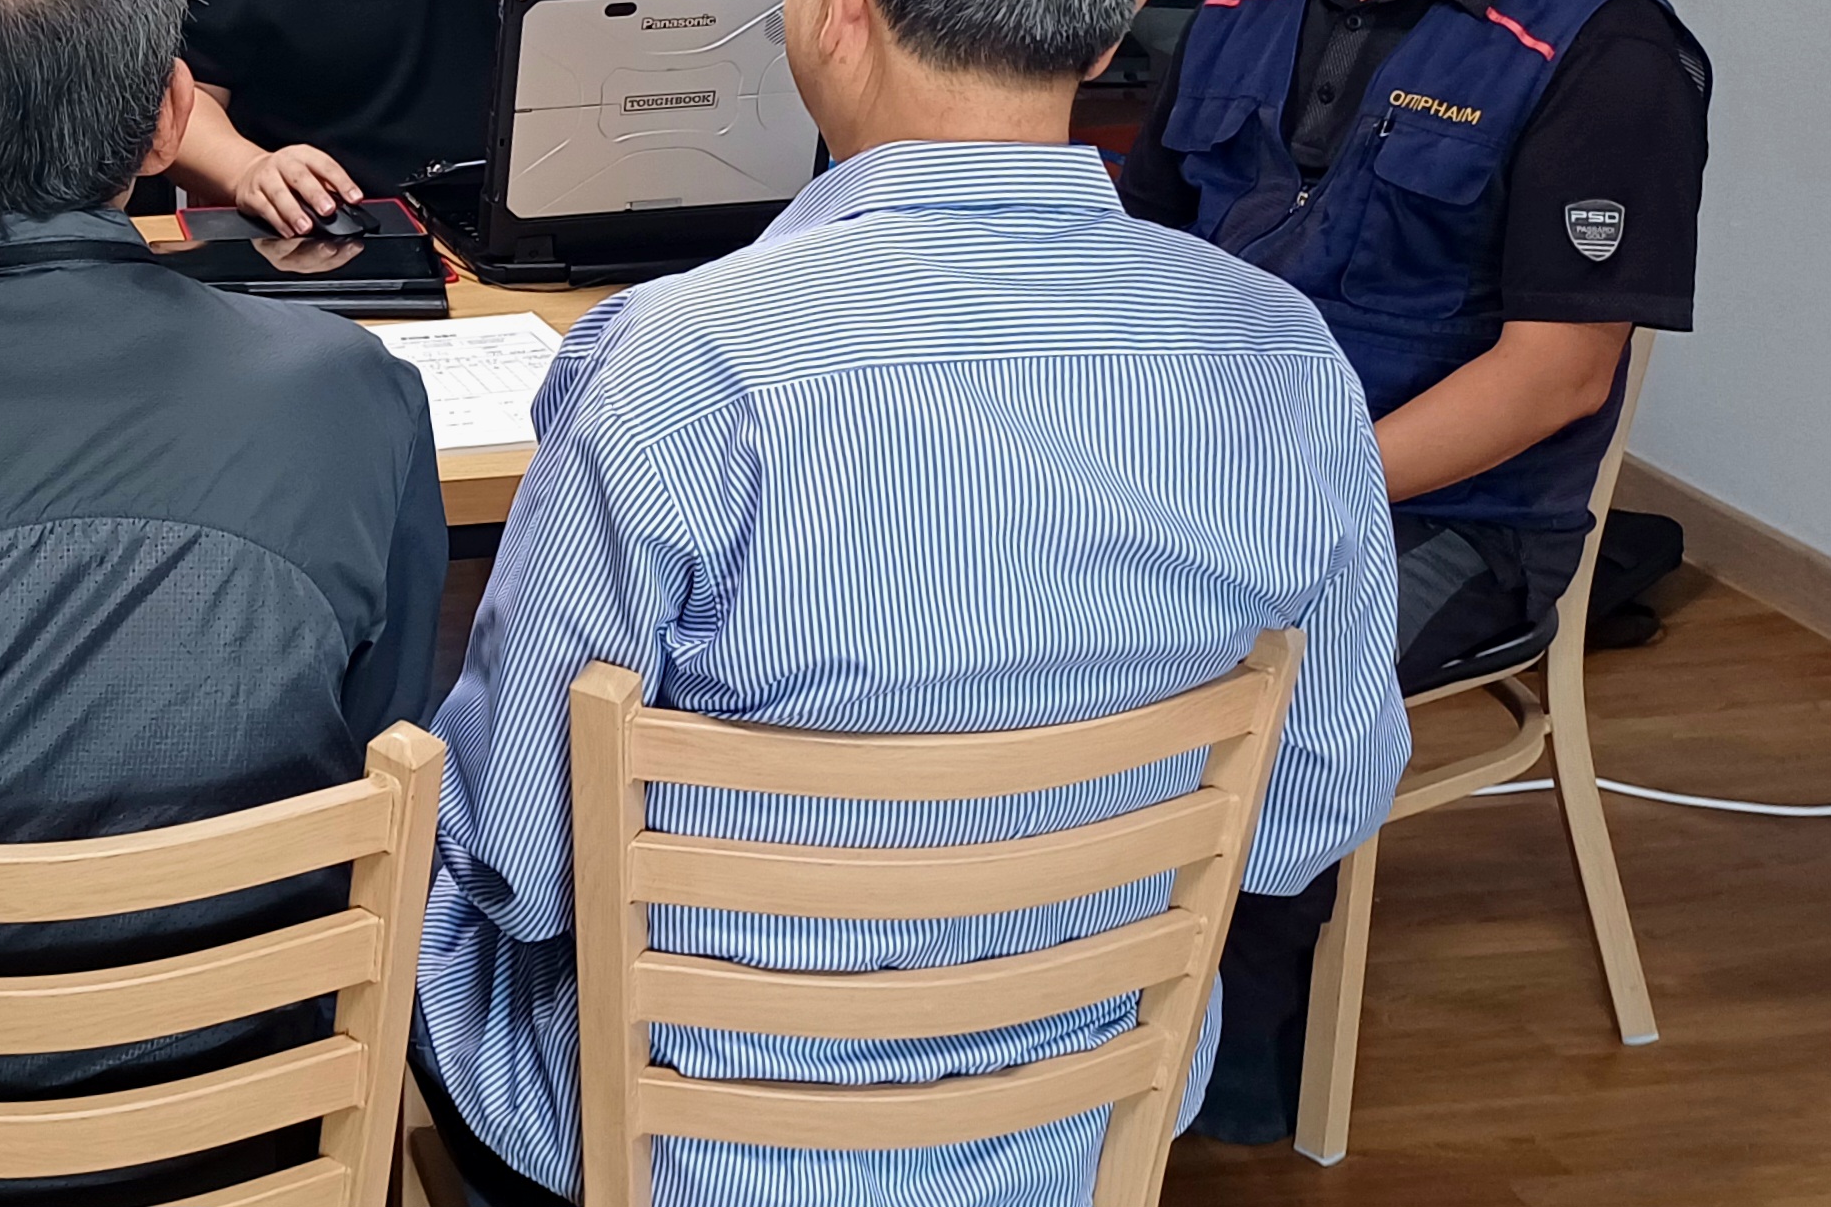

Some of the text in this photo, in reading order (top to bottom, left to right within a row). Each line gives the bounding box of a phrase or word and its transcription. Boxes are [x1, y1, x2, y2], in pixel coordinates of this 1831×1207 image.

[641, 14, 717, 31] Panasonic
[627, 93, 713, 110] TOUGHBOOK
[1570, 210, 1620, 223] PSD
